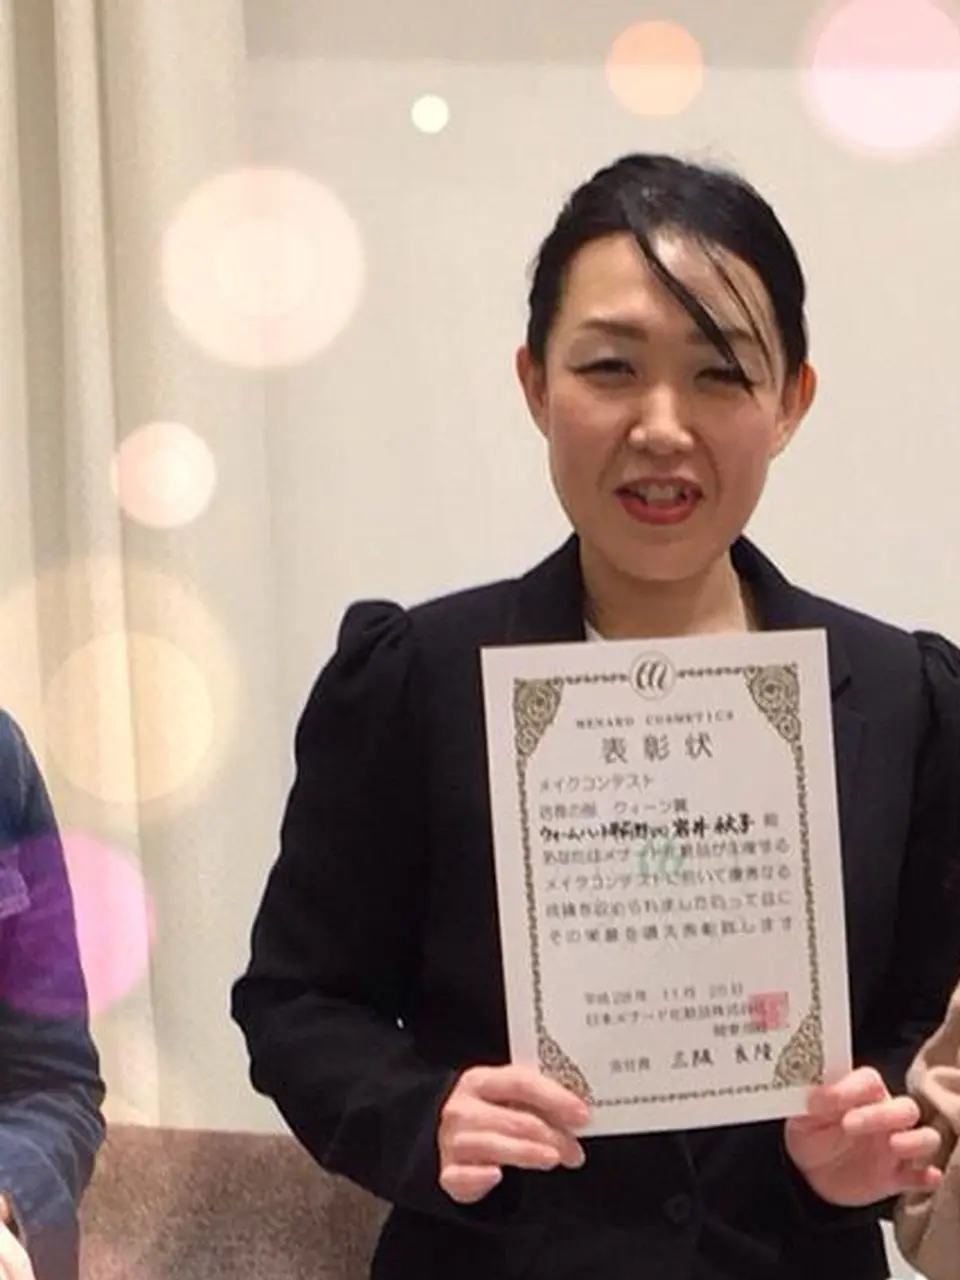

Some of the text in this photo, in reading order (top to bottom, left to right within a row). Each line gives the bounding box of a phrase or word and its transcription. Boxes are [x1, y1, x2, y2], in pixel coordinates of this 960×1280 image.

[576, 710, 734, 729] MENARD COSMETICS
[601, 732, 713, 764] 表彰状
[539, 773, 655, 794] メイクコンテスト
